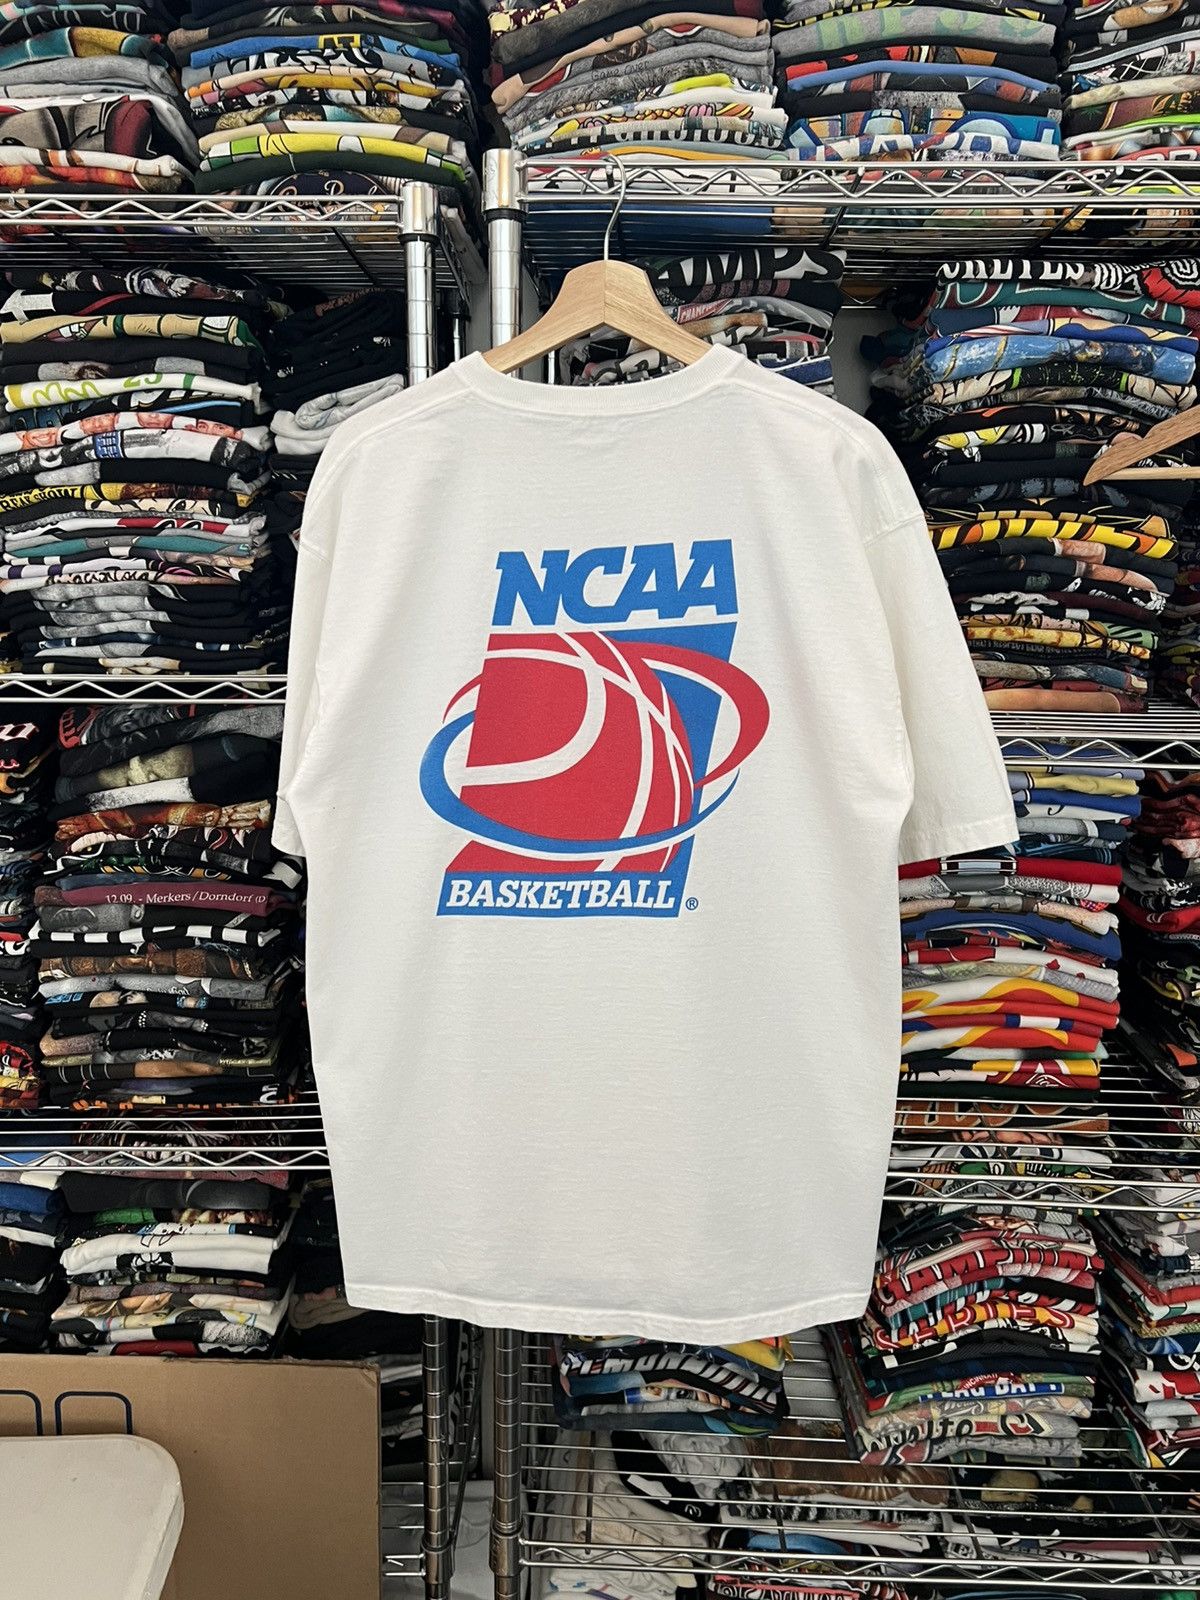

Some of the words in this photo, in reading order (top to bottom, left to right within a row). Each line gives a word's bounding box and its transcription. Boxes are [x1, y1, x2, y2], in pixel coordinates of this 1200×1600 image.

[491, 538, 738, 627] NCAA
[105, 894, 136, 904] 1209.
[446, 879, 676, 909] BASKETBALL
